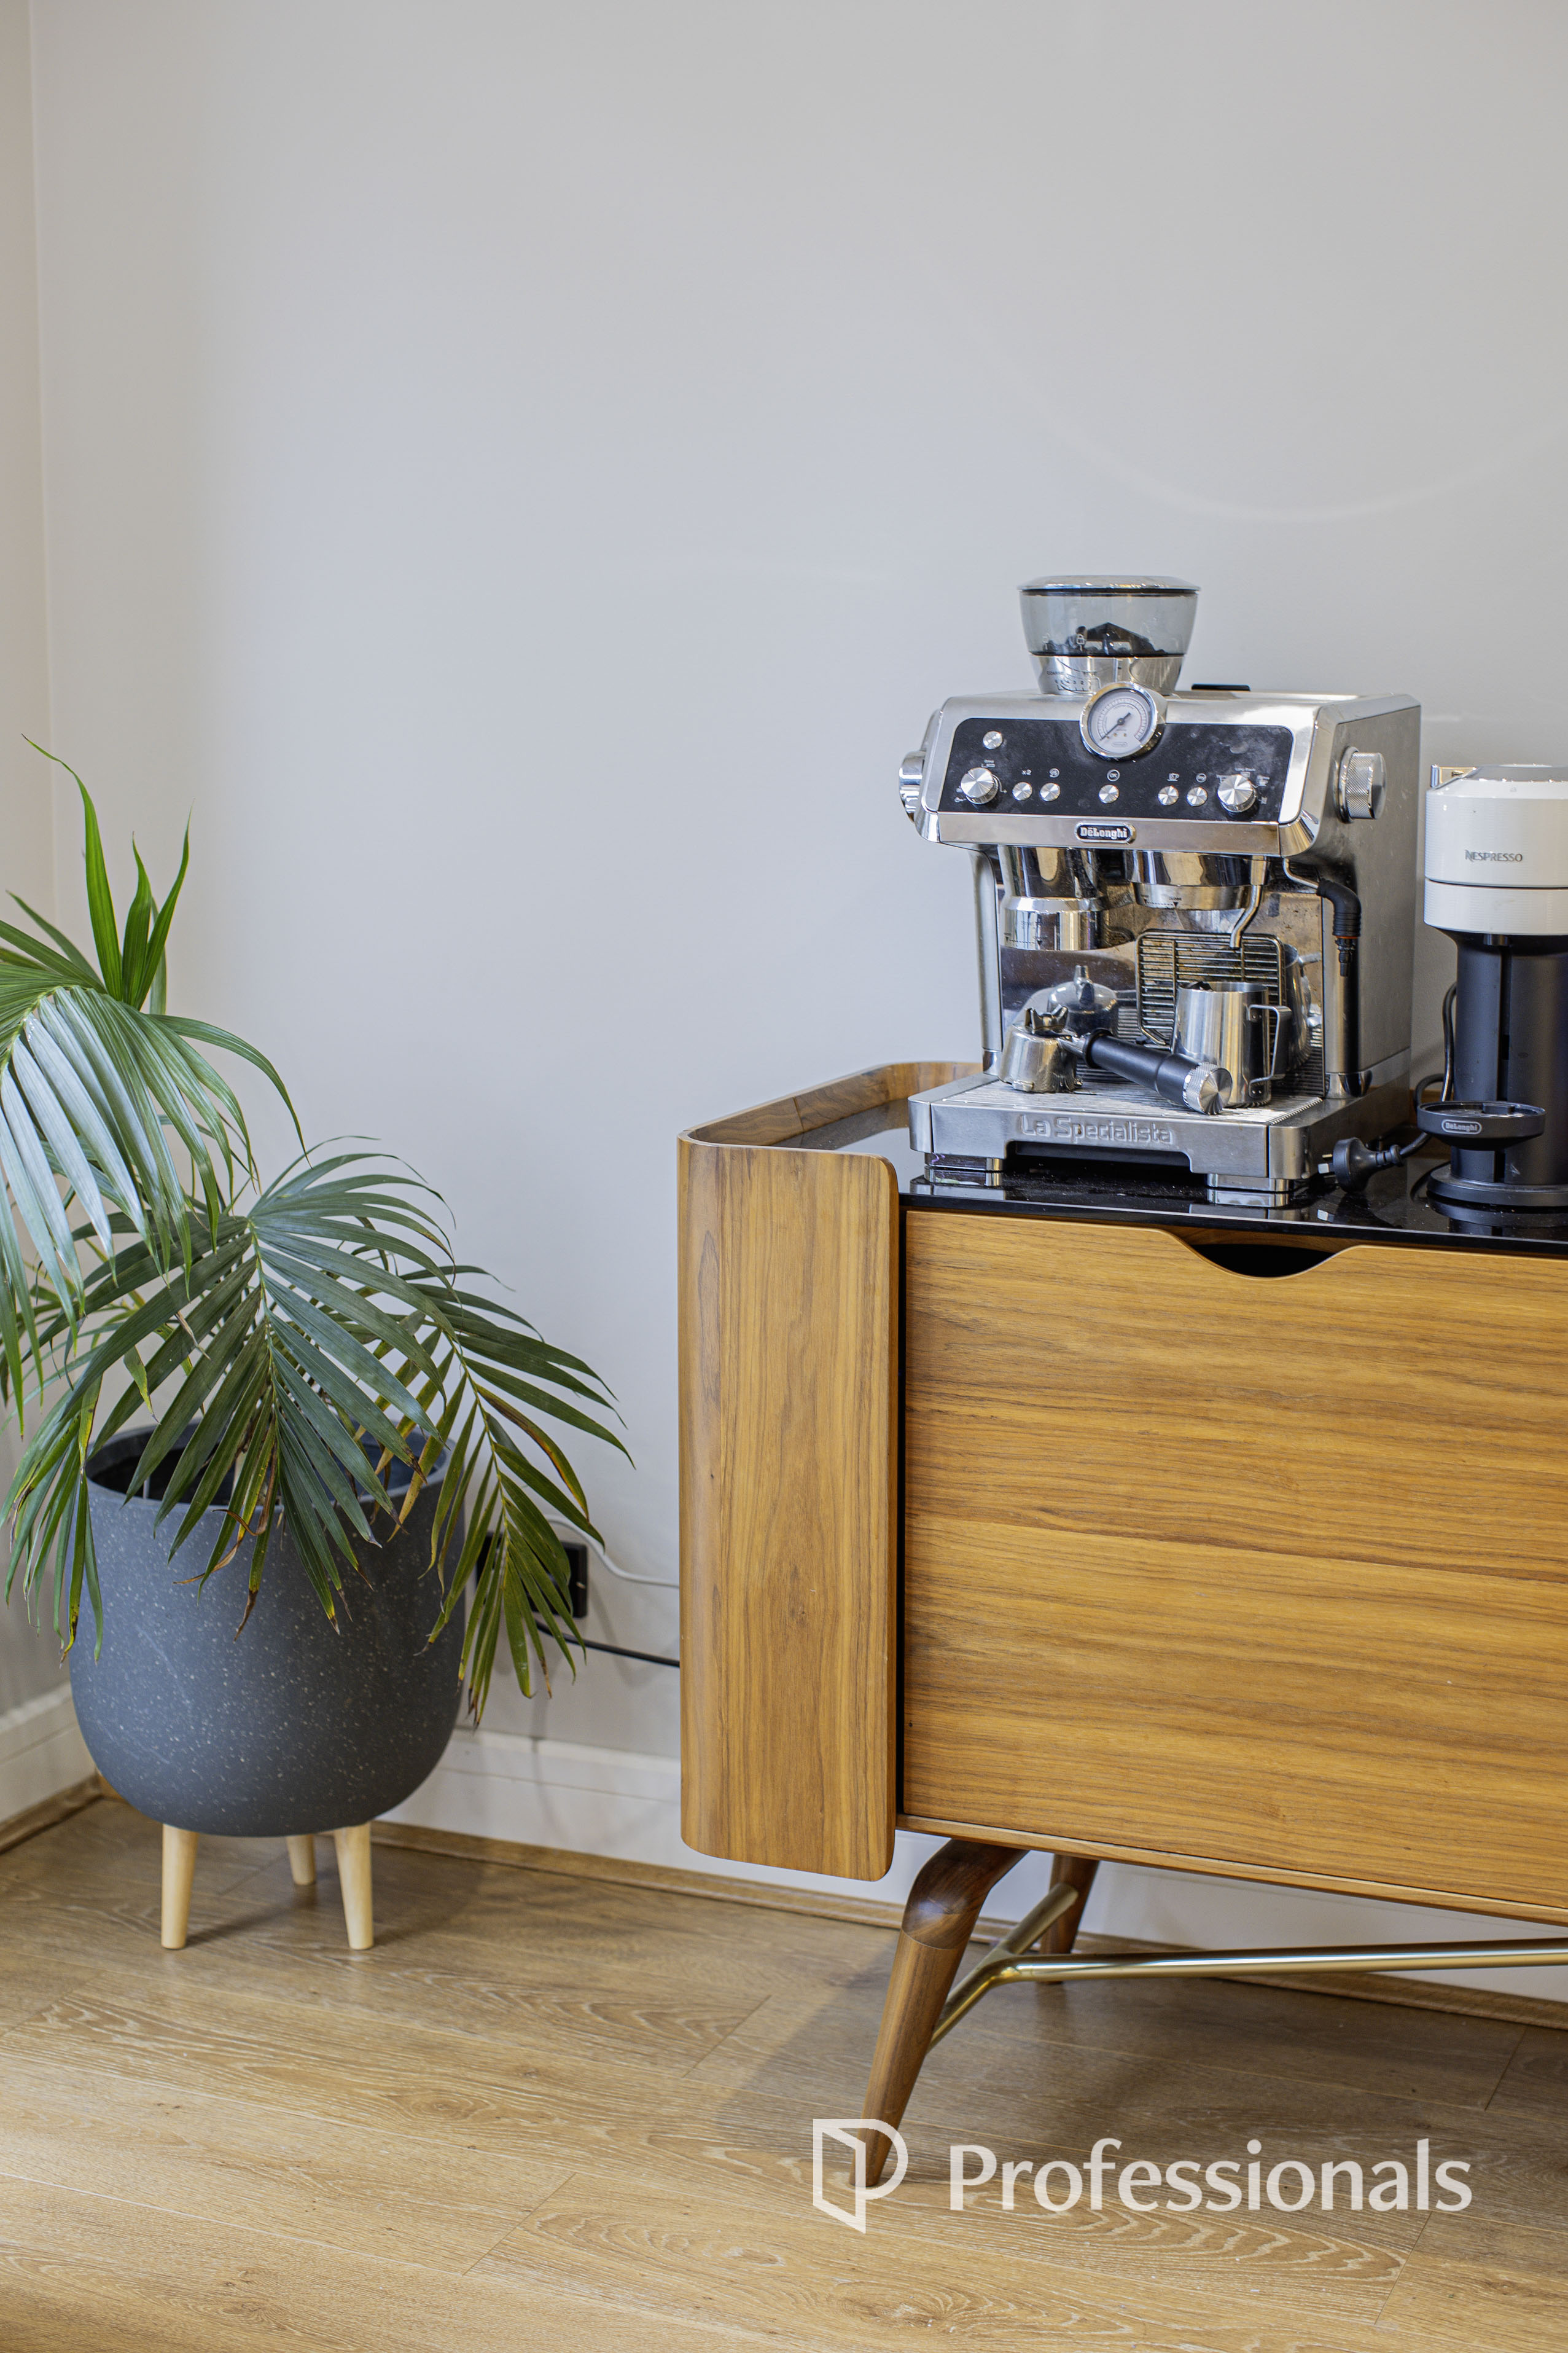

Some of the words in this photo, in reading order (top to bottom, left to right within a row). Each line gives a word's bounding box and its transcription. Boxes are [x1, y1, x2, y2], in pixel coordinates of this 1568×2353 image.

[1464, 849, 1523, 863] NESPRESSO
[1019, 1114, 1051, 1137] La
[1055, 1116, 1175, 1145] Specialista
